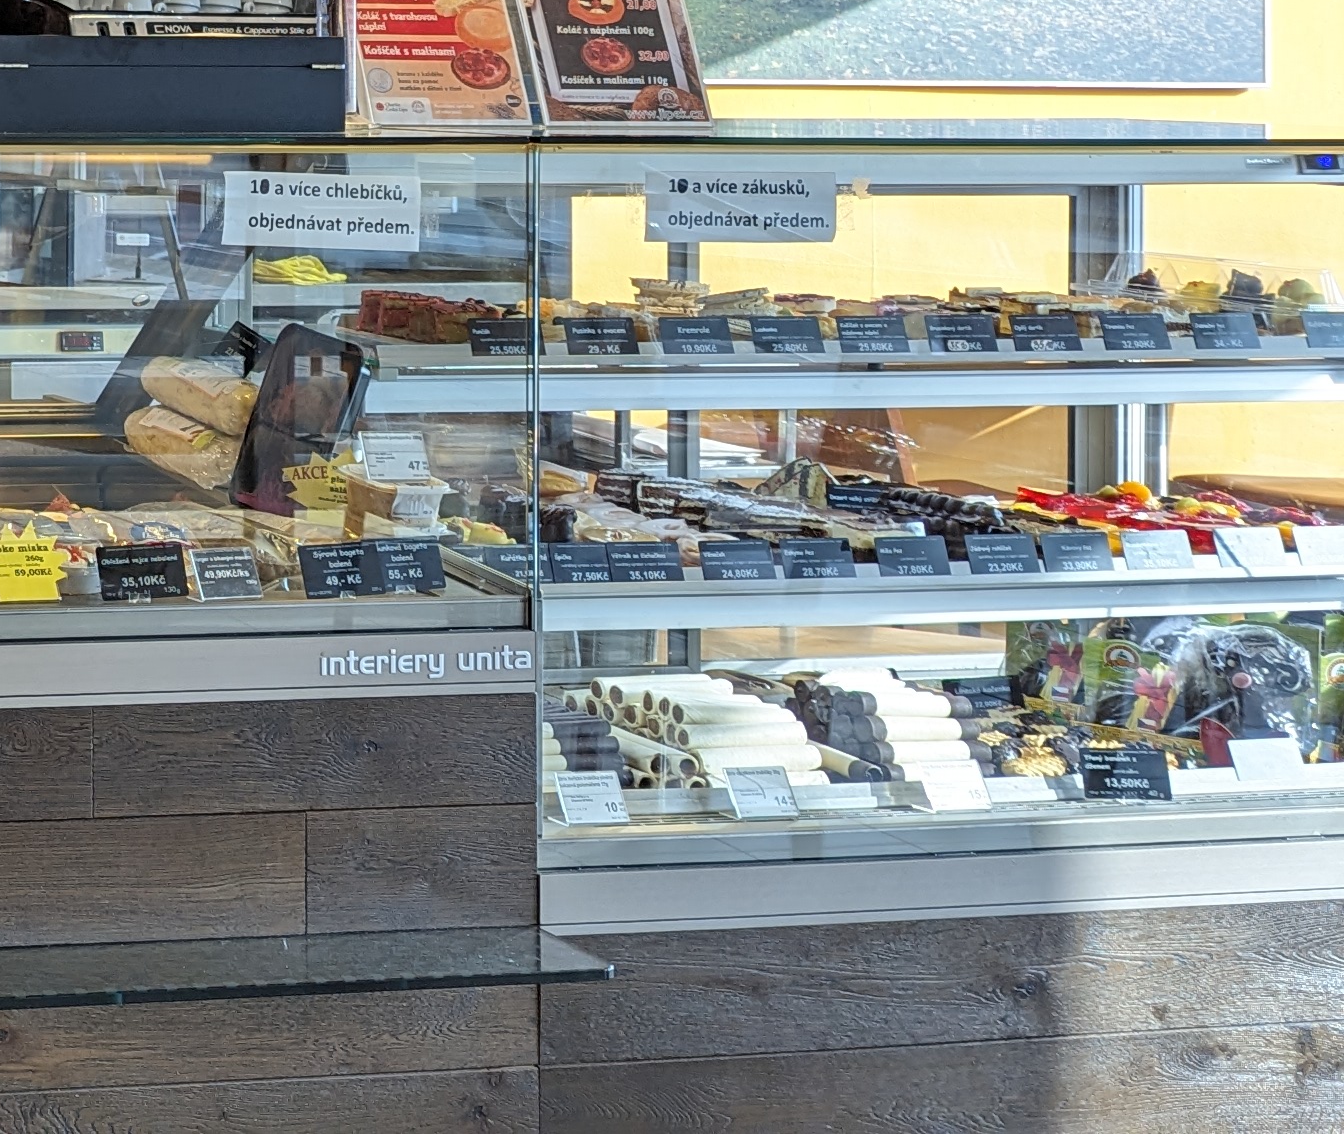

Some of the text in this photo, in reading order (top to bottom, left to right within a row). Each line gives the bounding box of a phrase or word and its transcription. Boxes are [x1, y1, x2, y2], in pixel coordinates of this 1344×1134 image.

[557, 26, 581, 34] Koláč
[633, 27, 654, 36] 100g
[647, 75, 668, 85] 110g
[274, 186, 284, 196] a
[289, 181, 321, 198] více
[325, 181, 408, 204] chlebíčků,
[693, 183, 702, 194] a
[706, 178, 737, 195] více
[741, 178, 810, 199] zákusků,
[248, 214, 415, 239] objednávat předem.
[668, 210, 829, 232] objednávat předem.
[292, 466, 328, 480] AKCE
[325, 574, 362, 587] 49,- Kč
[388, 568, 423, 580] 55,- Kč
[121, 575, 166, 588] 35,10Kč
[320, 644, 532, 678] interiery unita
[1104, 778, 1149, 789] 13,50Kč
